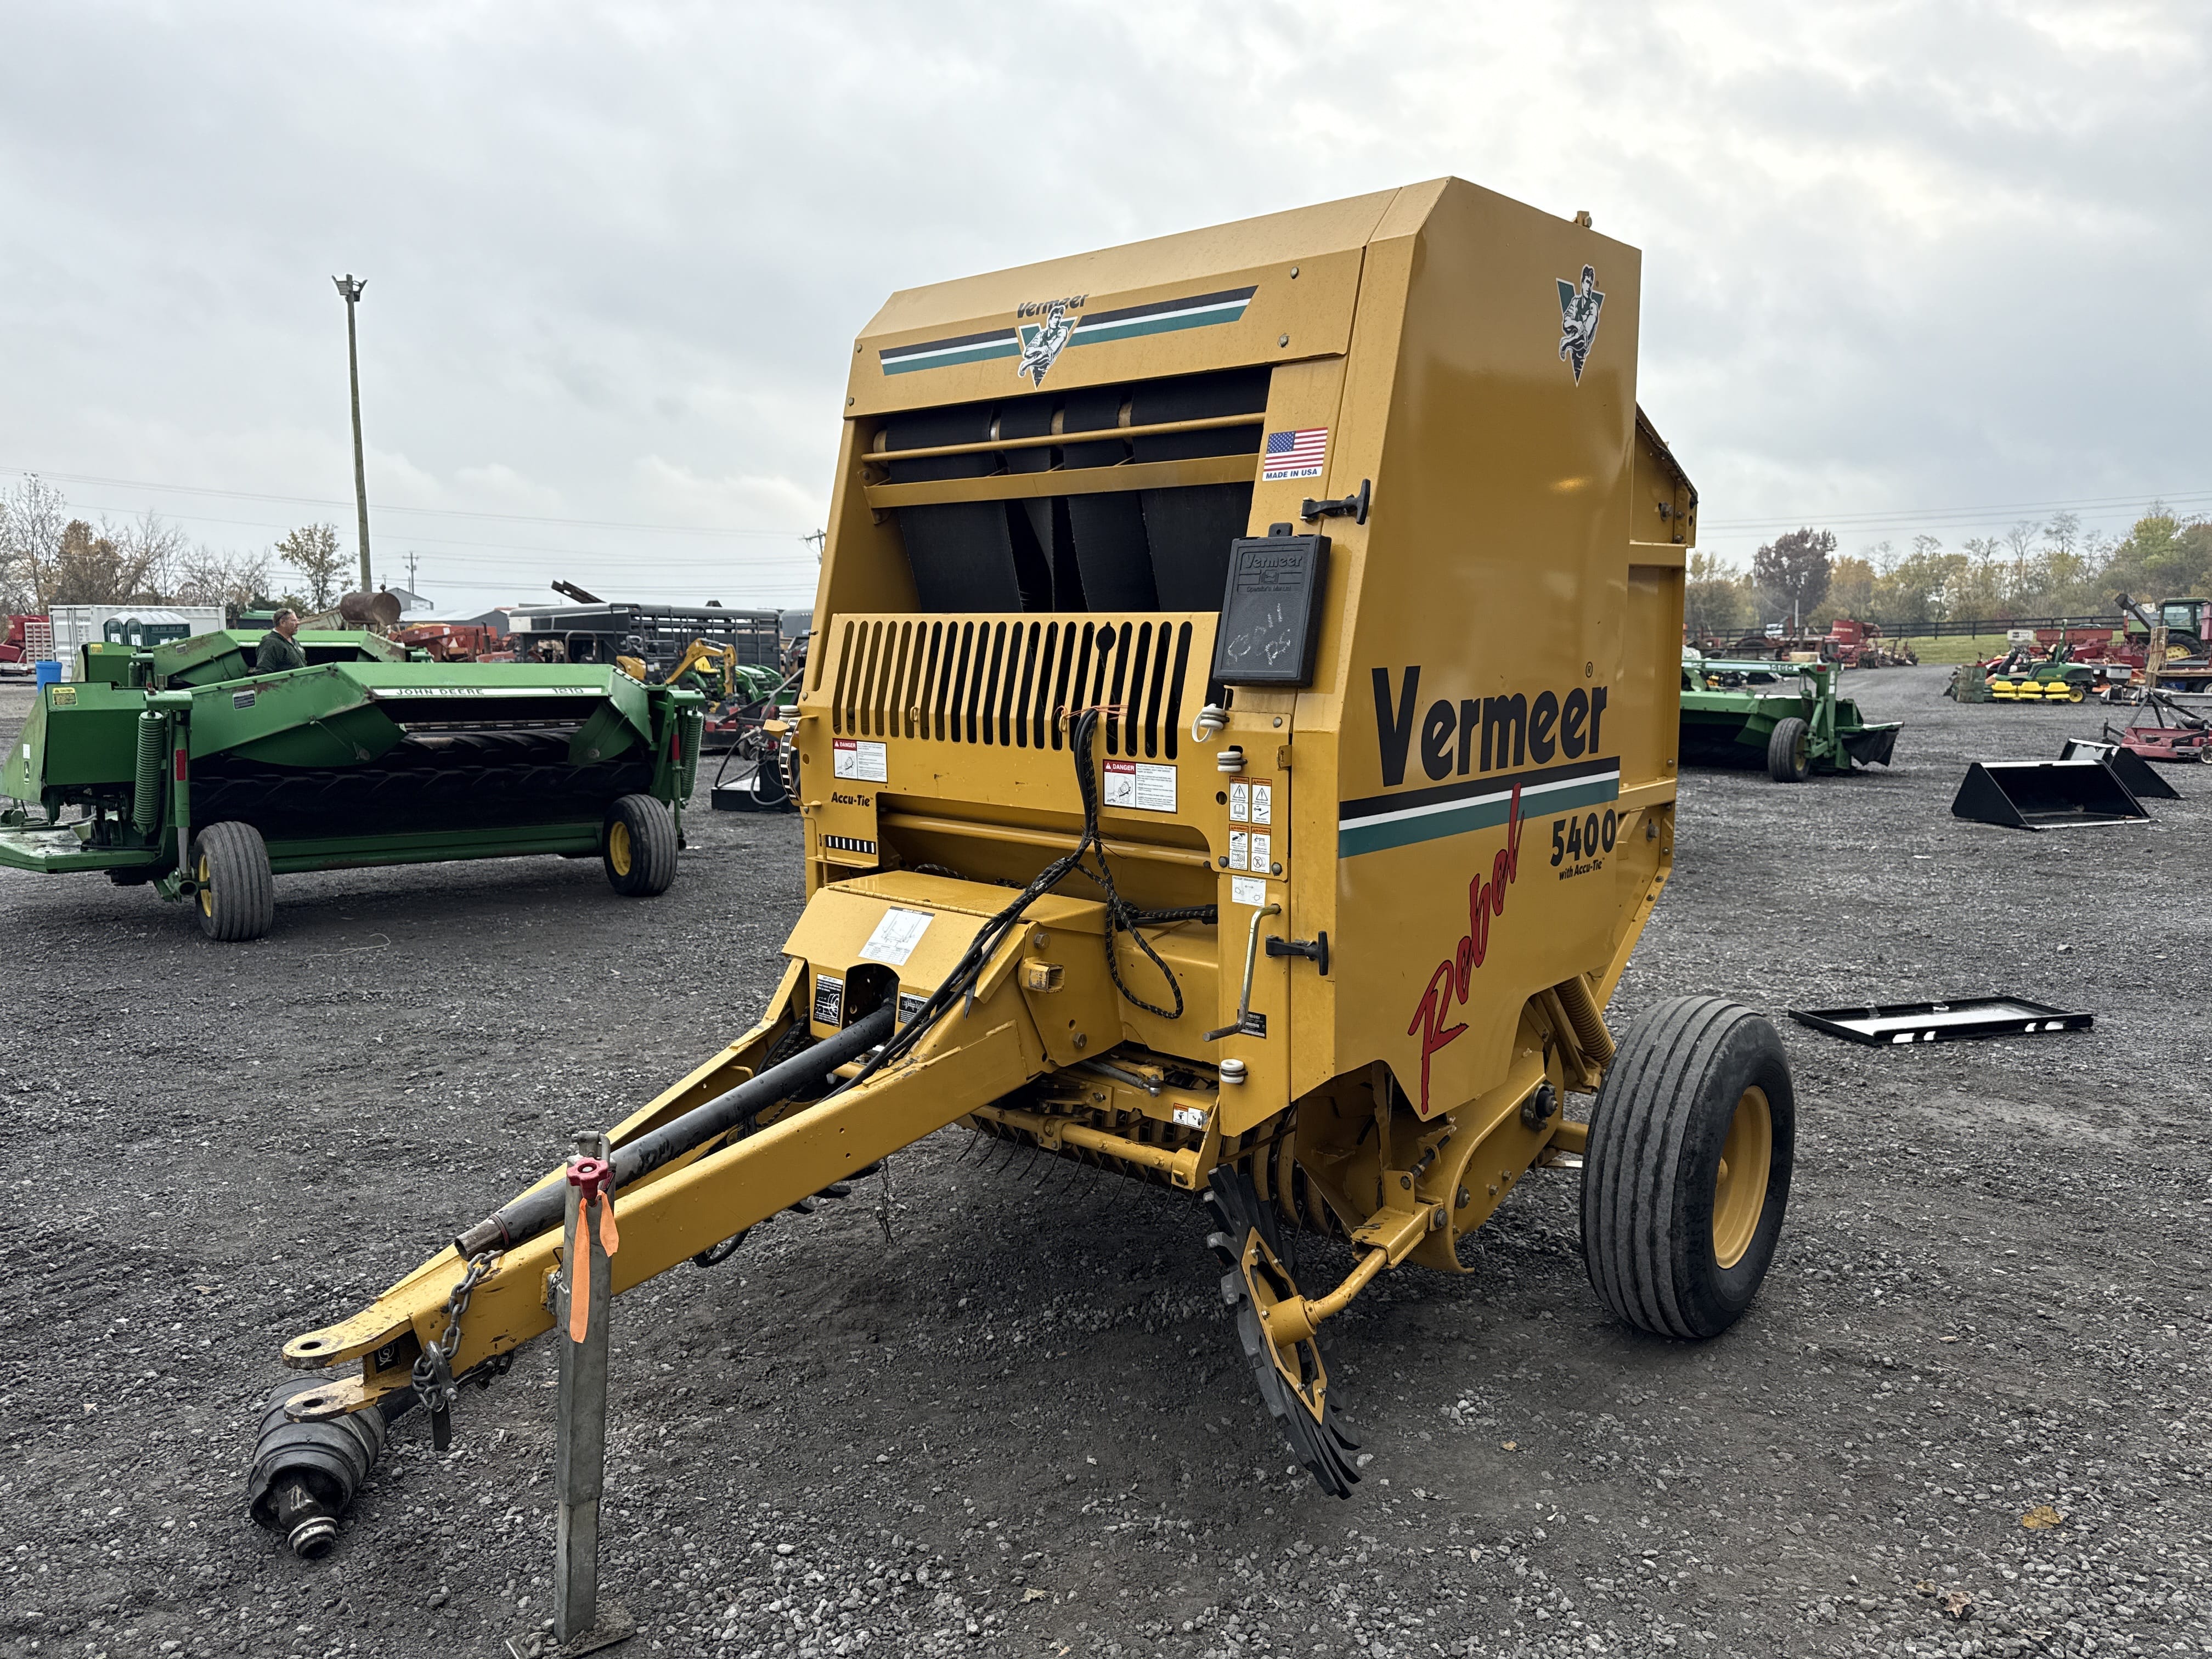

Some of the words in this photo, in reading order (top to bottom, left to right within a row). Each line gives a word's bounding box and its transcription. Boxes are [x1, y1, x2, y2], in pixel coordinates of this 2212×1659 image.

[1017, 294, 1090, 318] Vermeer
[1266, 471, 1288, 479] MADE
[1244, 554, 1303, 568] Vermeer
[1372, 665, 1607, 787] Vermeer
[831, 792, 870, 807] Accu-Tie
[1550, 808, 1617, 867] 5400
[1559, 866, 1573, 881] with
[1574, 859, 1602, 877] Accu-Tie
[1408, 782, 1525, 1115] Rebel
